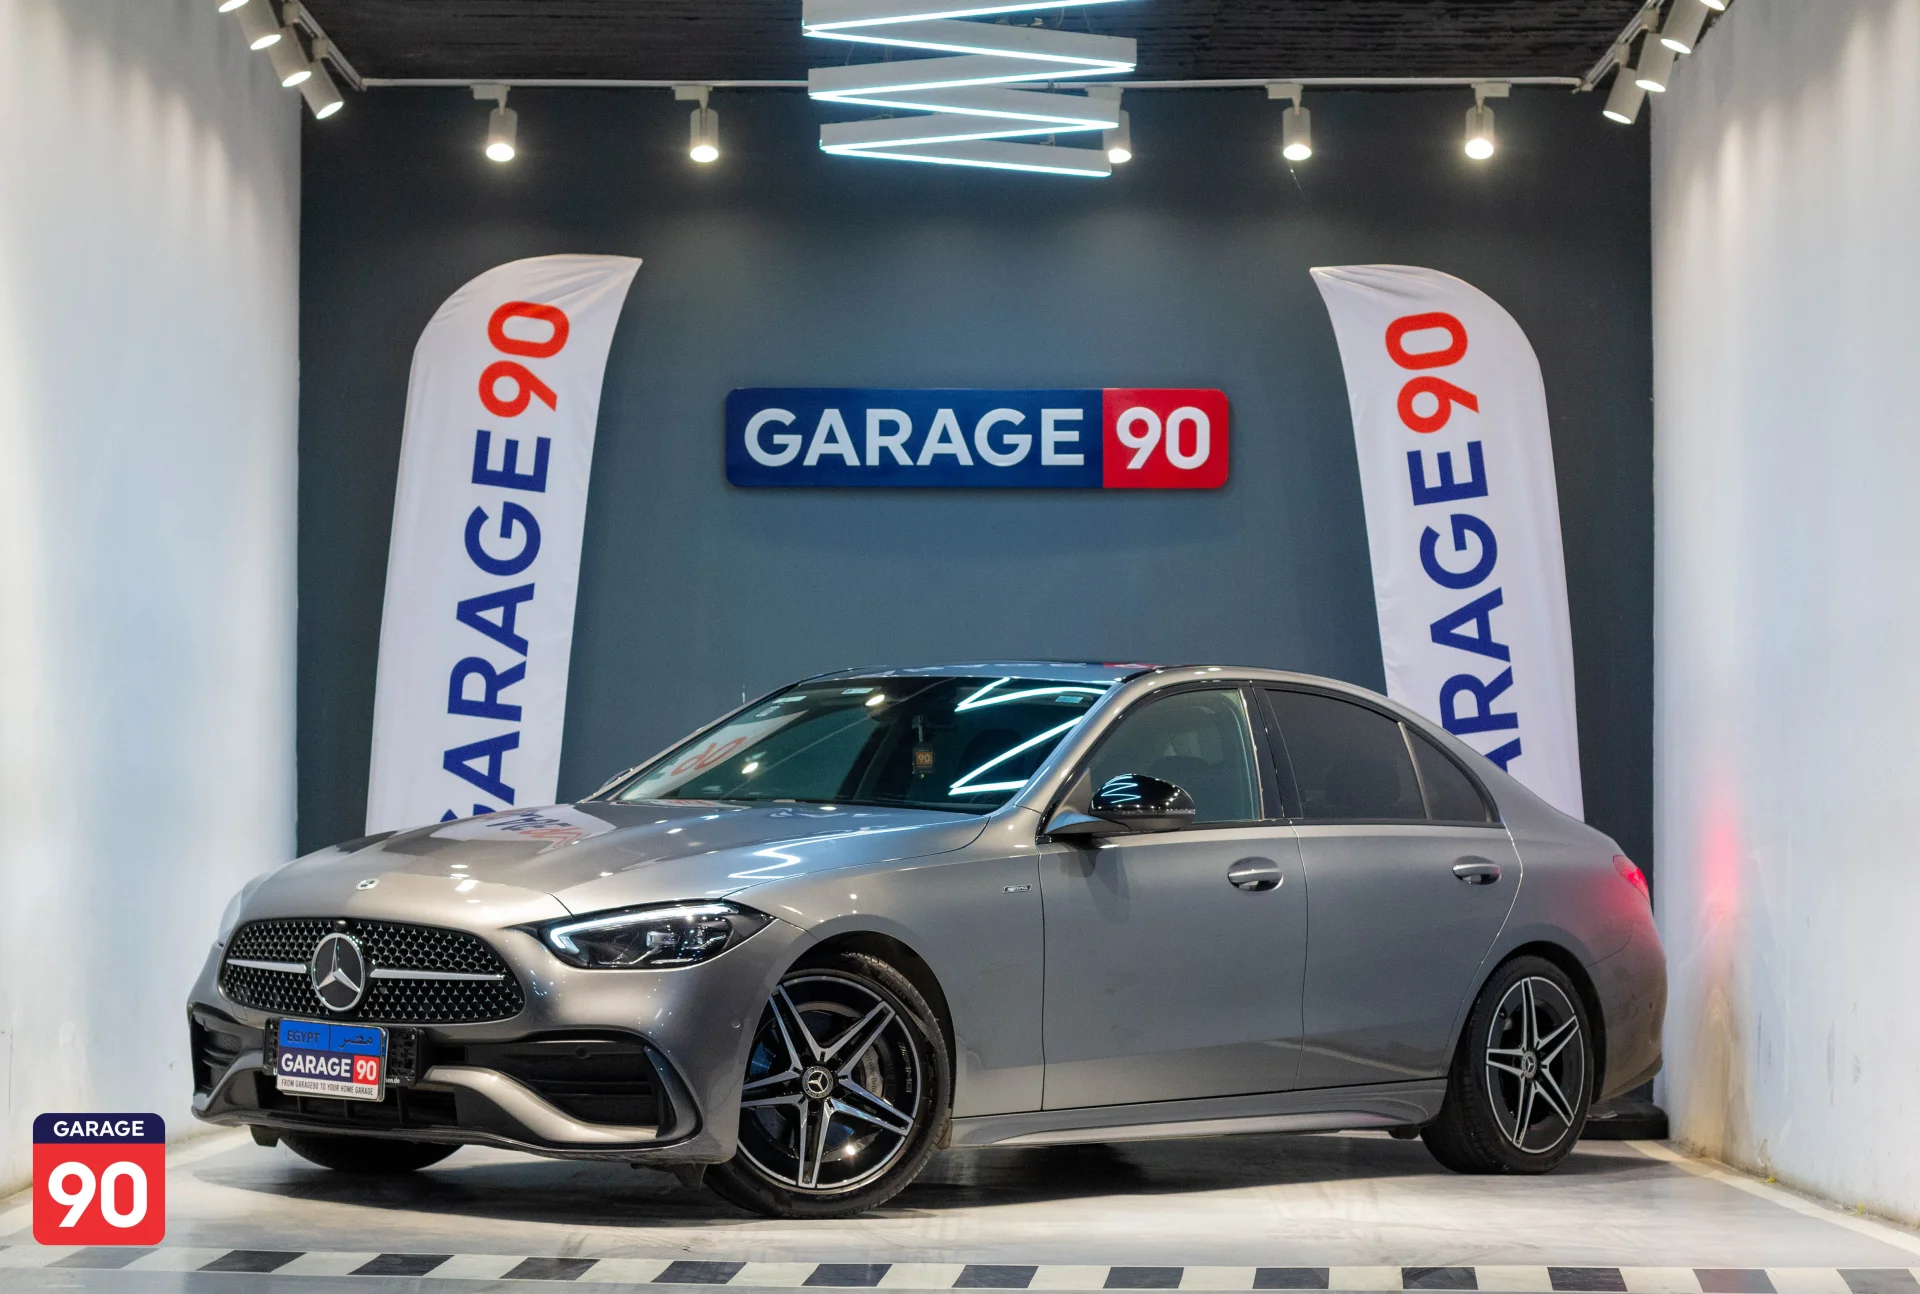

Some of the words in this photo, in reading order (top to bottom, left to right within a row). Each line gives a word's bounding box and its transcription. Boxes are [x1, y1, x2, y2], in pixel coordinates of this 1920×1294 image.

[744, 407, 1085, 467] GARAGE
[1115, 406, 1211, 470] 90
[287, 1030, 320, 1043] EGYPT
[338, 1035, 373, 1048] مصر
[281, 1053, 352, 1077] GARAGE
[356, 1060, 377, 1081] 90
[281, 1078, 295, 1087] FROM
[295, 1080, 319, 1089] GARAGE90
[320, 1082, 327, 1090] TO
[327, 1083, 340, 1092] YOUR
[340, 1084, 354, 1094] HOME
[355, 1086, 373, 1095] GARAGE
